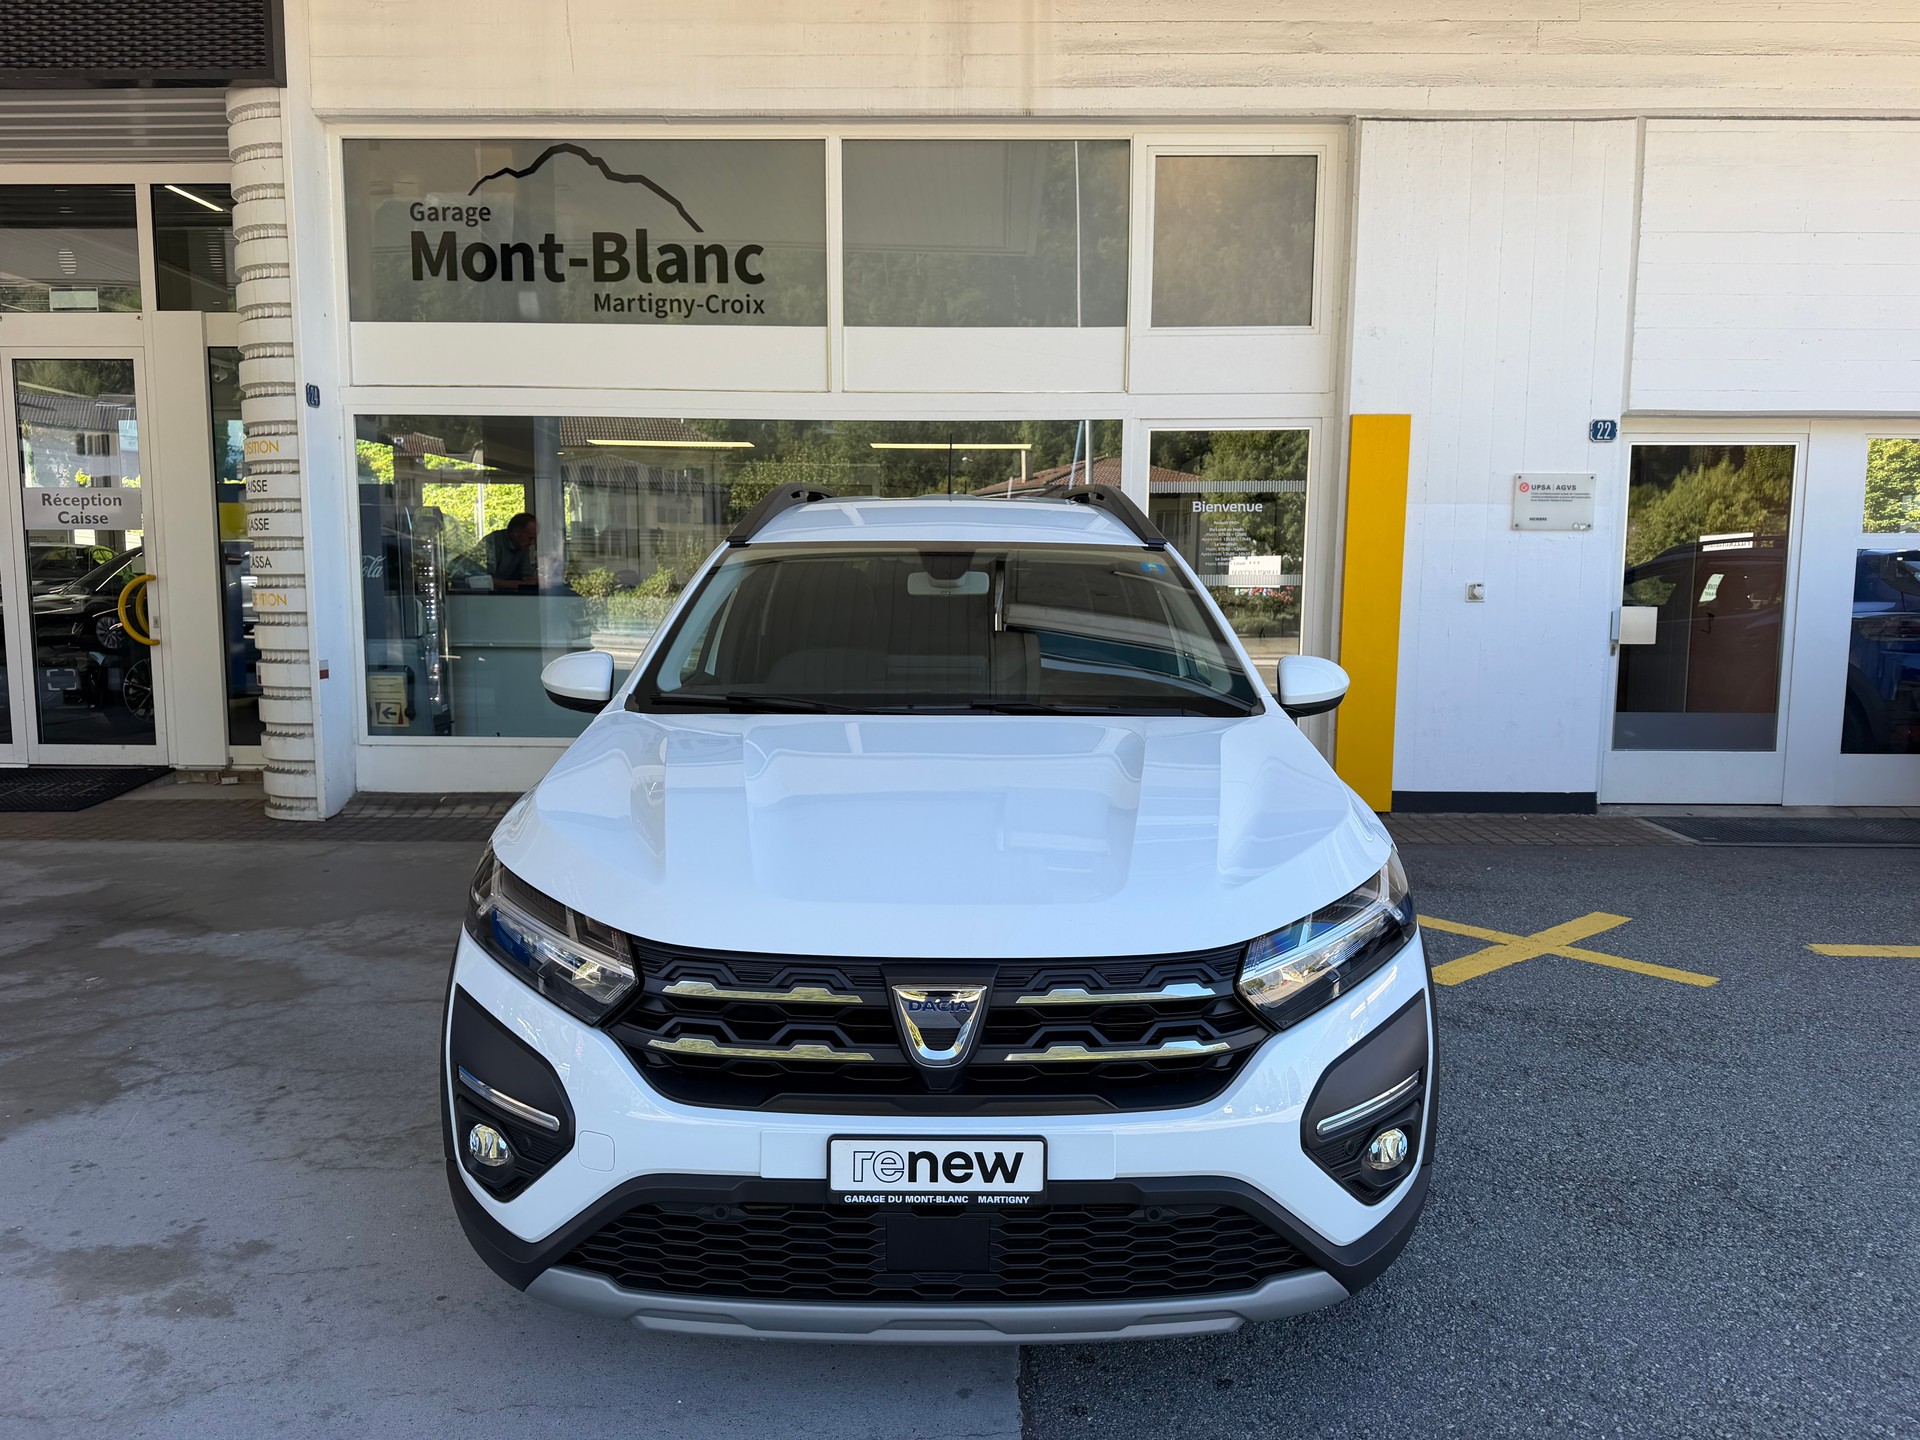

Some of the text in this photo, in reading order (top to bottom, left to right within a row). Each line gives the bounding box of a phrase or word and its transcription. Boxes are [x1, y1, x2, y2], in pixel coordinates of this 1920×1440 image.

[409, 202, 491, 227] Garage
[410, 228, 765, 285] Mont-Blanc
[593, 293, 765, 318] Martigny-Croix
[1597, 421, 1611, 439] 22
[247, 479, 268, 493] AISSE
[41, 493, 122, 510] Réception
[1192, 501, 1263, 513] Bienvenue
[57, 511, 109, 525] Caisse
[250, 556, 272, 569] ASSA
[361, 554, 387, 579] ola
[908, 1000, 970, 1013] DACIA
[852, 1150, 1024, 1184] renew
[844, 1194, 1030, 1204] GARAGE DU MONT-BLANC MARTIGNY
